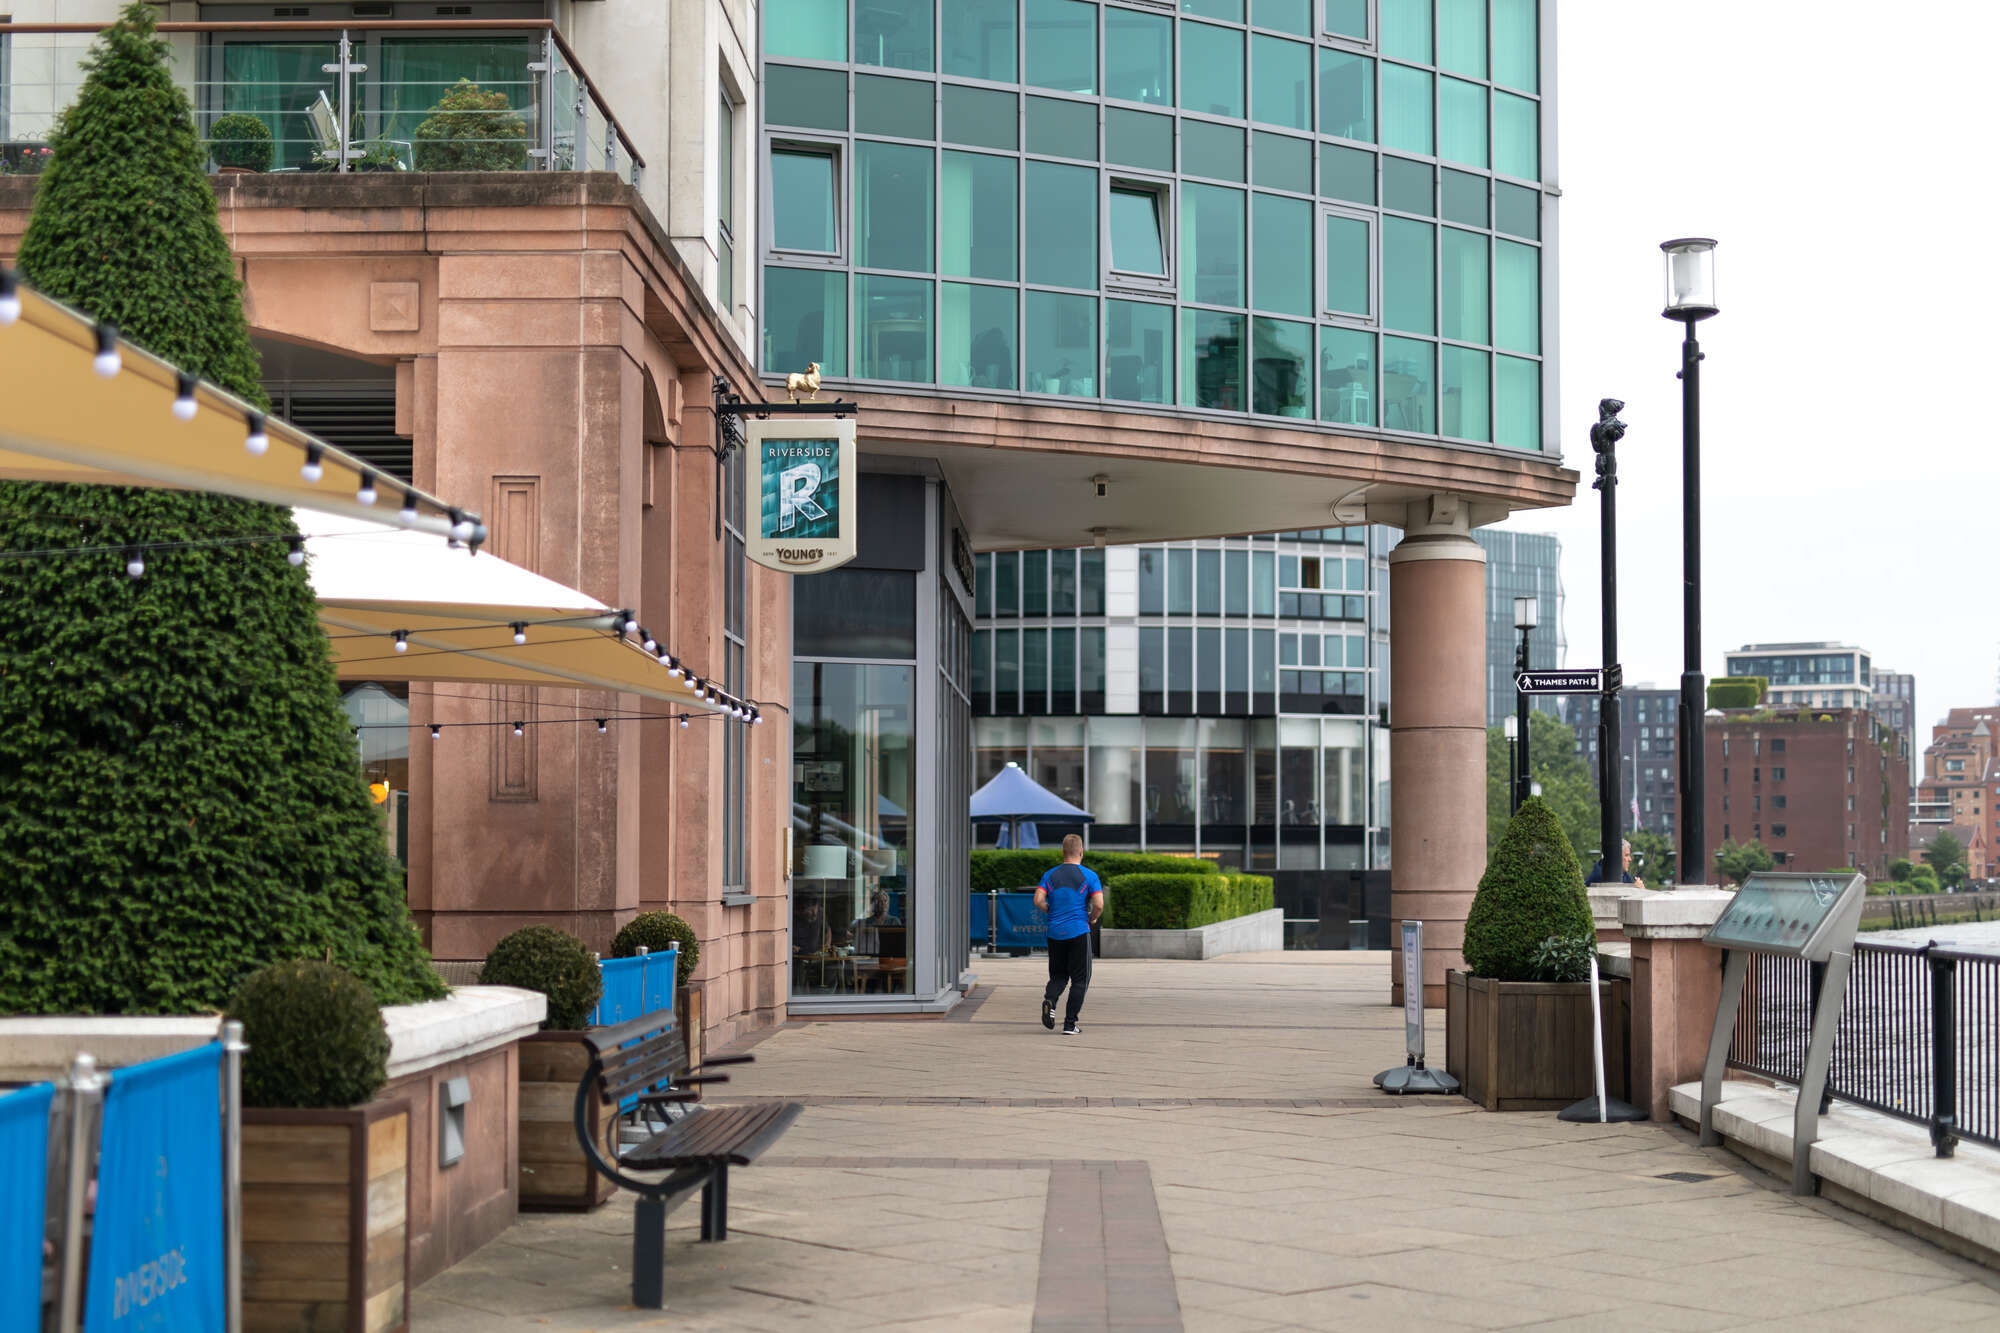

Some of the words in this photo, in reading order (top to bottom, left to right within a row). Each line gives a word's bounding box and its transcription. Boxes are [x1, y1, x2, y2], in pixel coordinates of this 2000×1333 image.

[769, 447, 831, 457] RIVERSIDE
[780, 463, 828, 531] R
[776, 548, 824, 560] YOUNG'S
[1568, 678, 1589, 686] PATH
